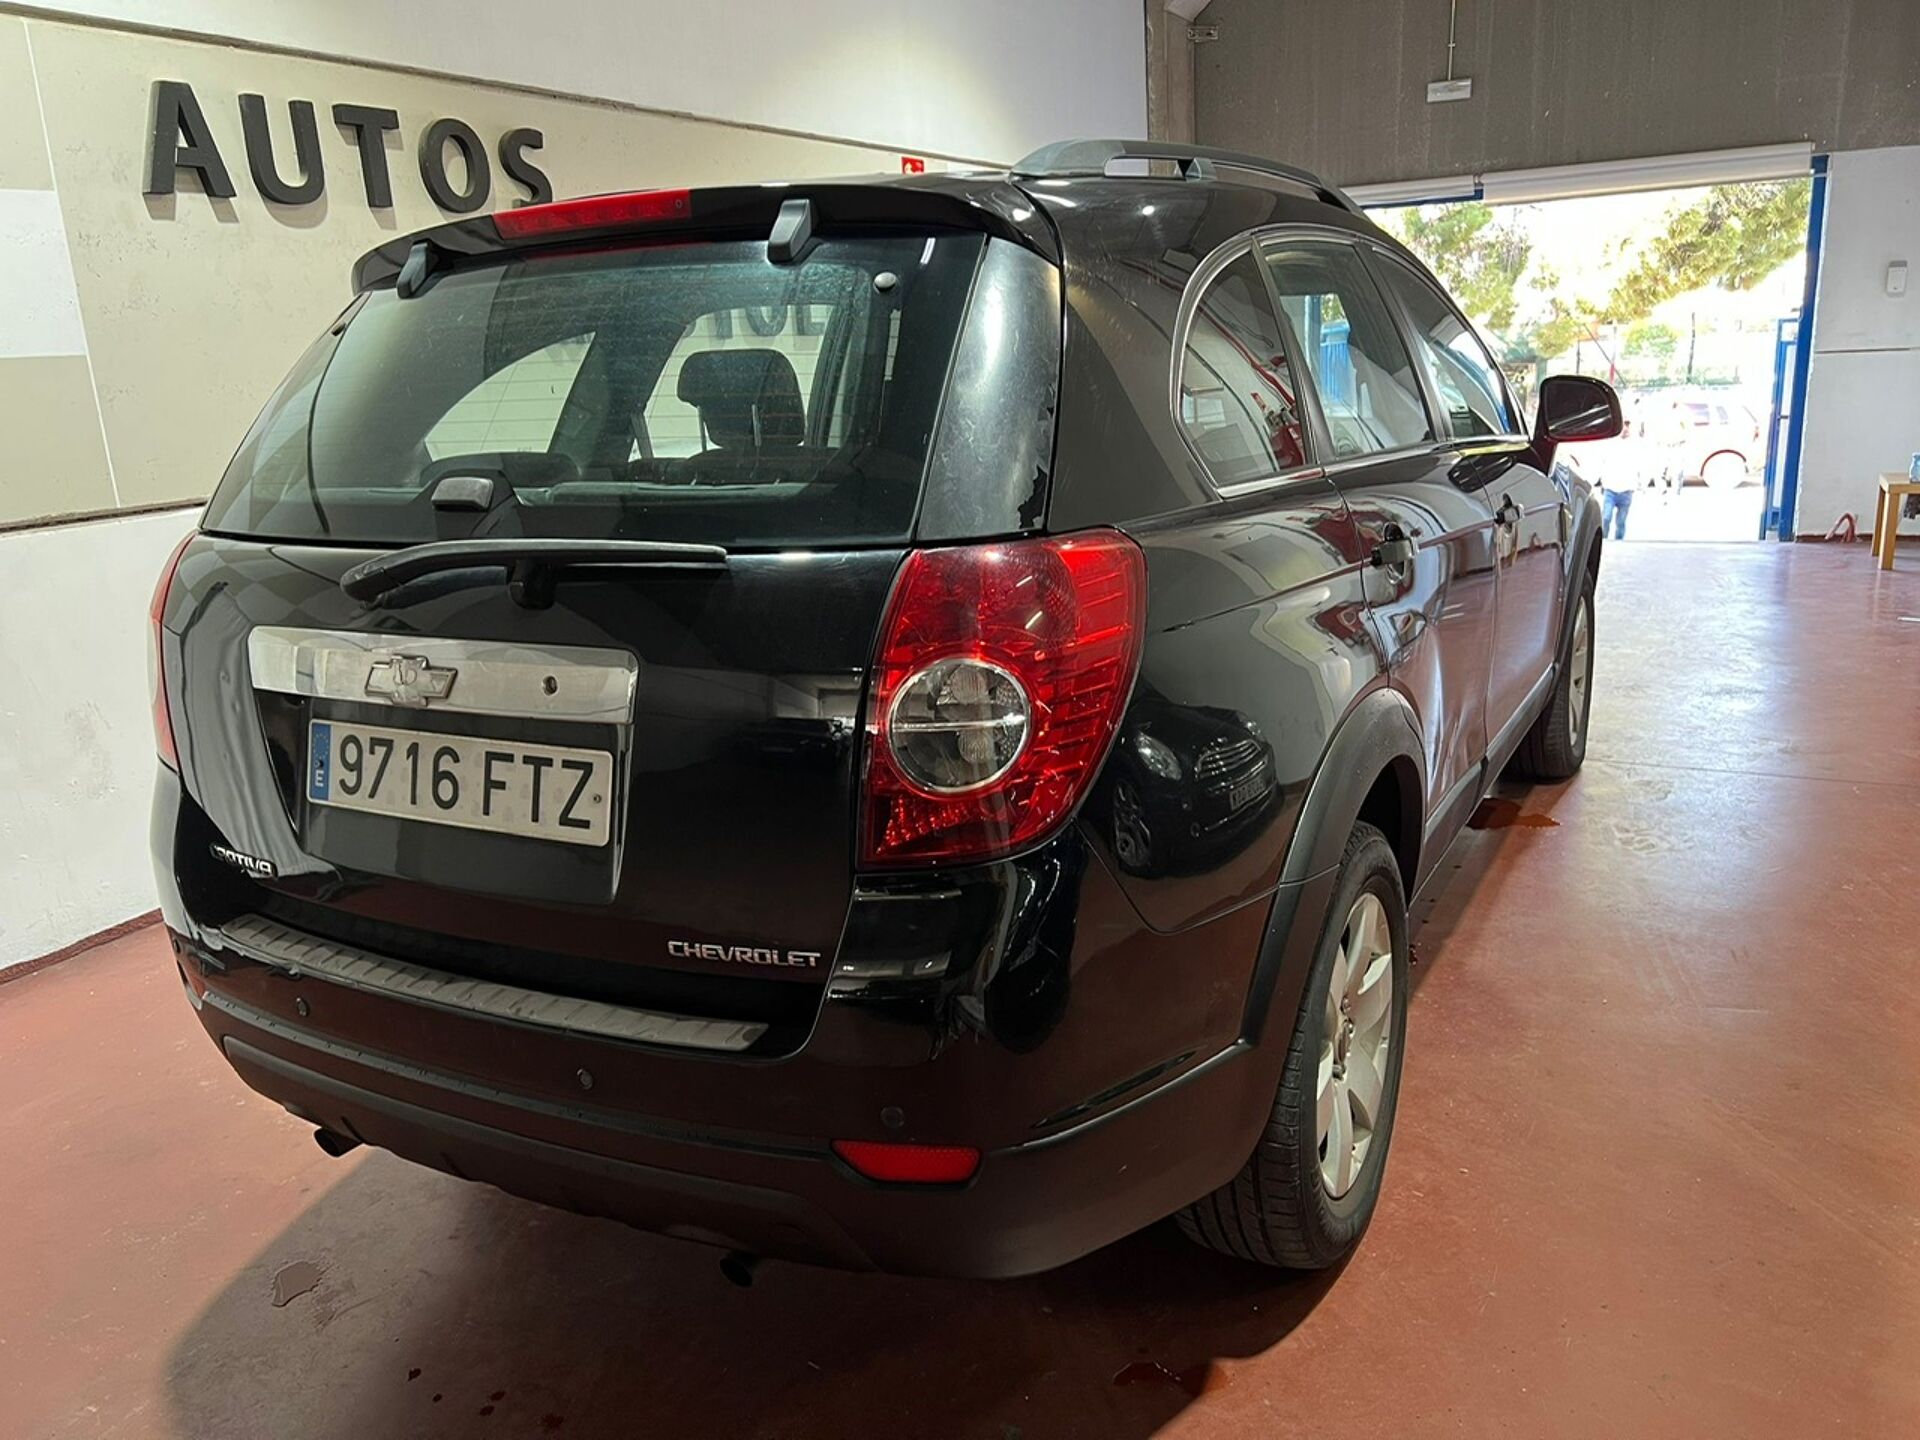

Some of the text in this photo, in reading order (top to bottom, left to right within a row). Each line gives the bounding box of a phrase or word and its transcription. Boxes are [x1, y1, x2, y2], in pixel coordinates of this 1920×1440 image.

[143, 79, 553, 214] AUTOS
[314, 734, 594, 830] E 9716 FTZ
[667, 940, 821, 967] CHEVROLET
